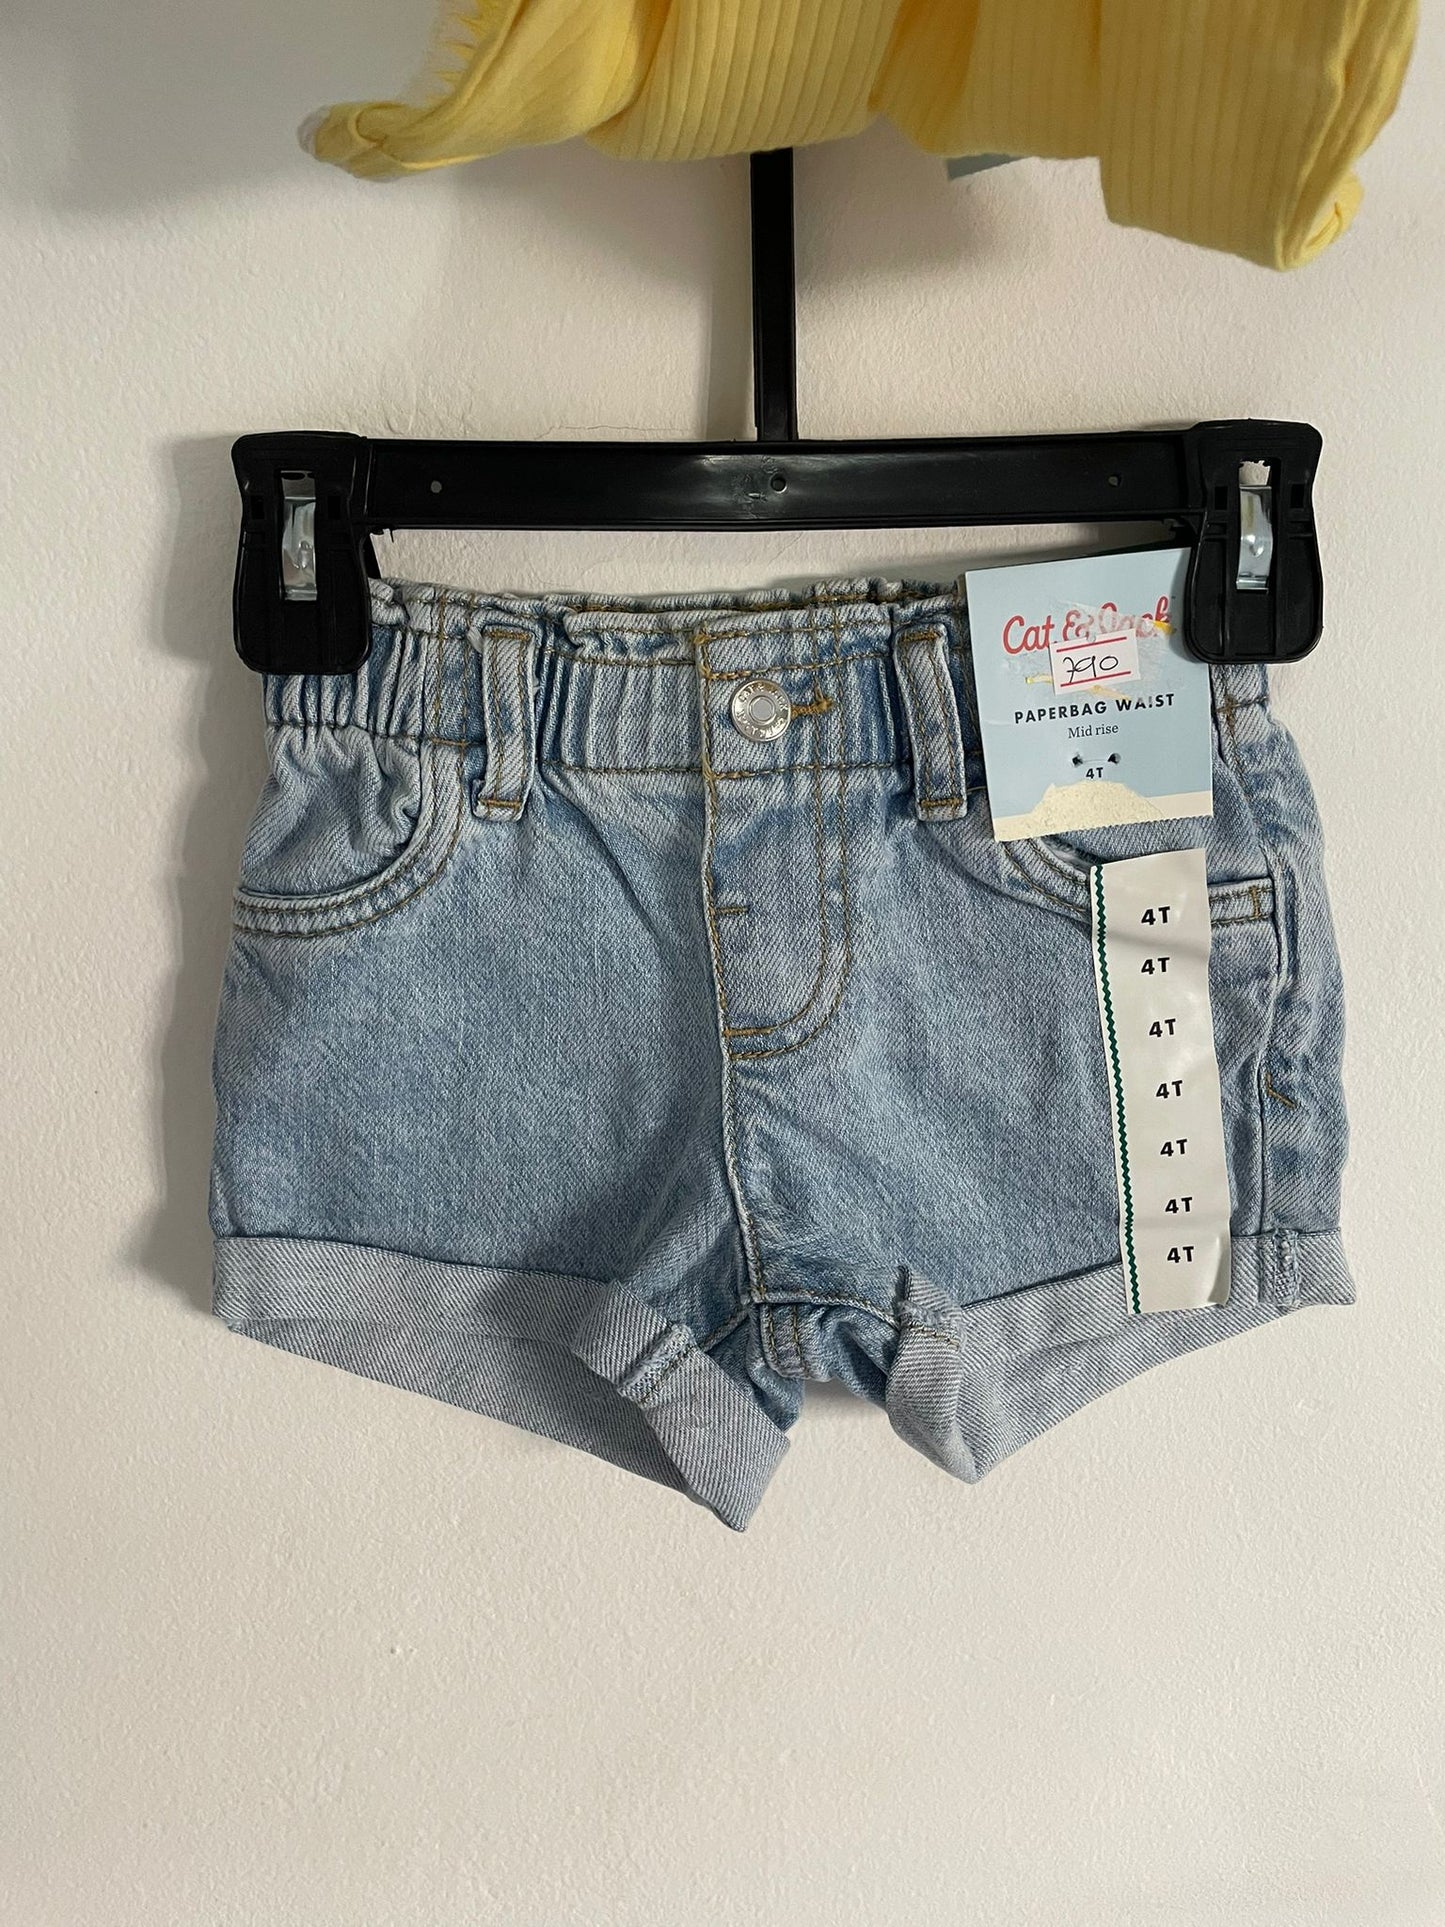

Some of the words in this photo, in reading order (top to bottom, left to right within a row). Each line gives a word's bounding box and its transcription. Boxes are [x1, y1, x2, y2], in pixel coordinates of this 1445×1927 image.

[1003, 615, 1055, 655] Cat
[1062, 655, 1119, 684] 790
[1014, 701, 1107, 724] PAPERBAG
[1115, 693, 1175, 712] WAIST
[1068, 724, 1093, 739] Mid
[1095, 724, 1119, 736] rise
[1085, 767, 1104, 779] 4T
[1140, 906, 1171, 926] 4T
[1140, 957, 1171, 975] 4T
[1149, 1018, 1177, 1038] 4T
[1155, 1079, 1184, 1099] 4T
[1160, 1138, 1188, 1157] 4T
[1164, 1196, 1193, 1214] 4T
[1166, 1246, 1195, 1264] 4T
